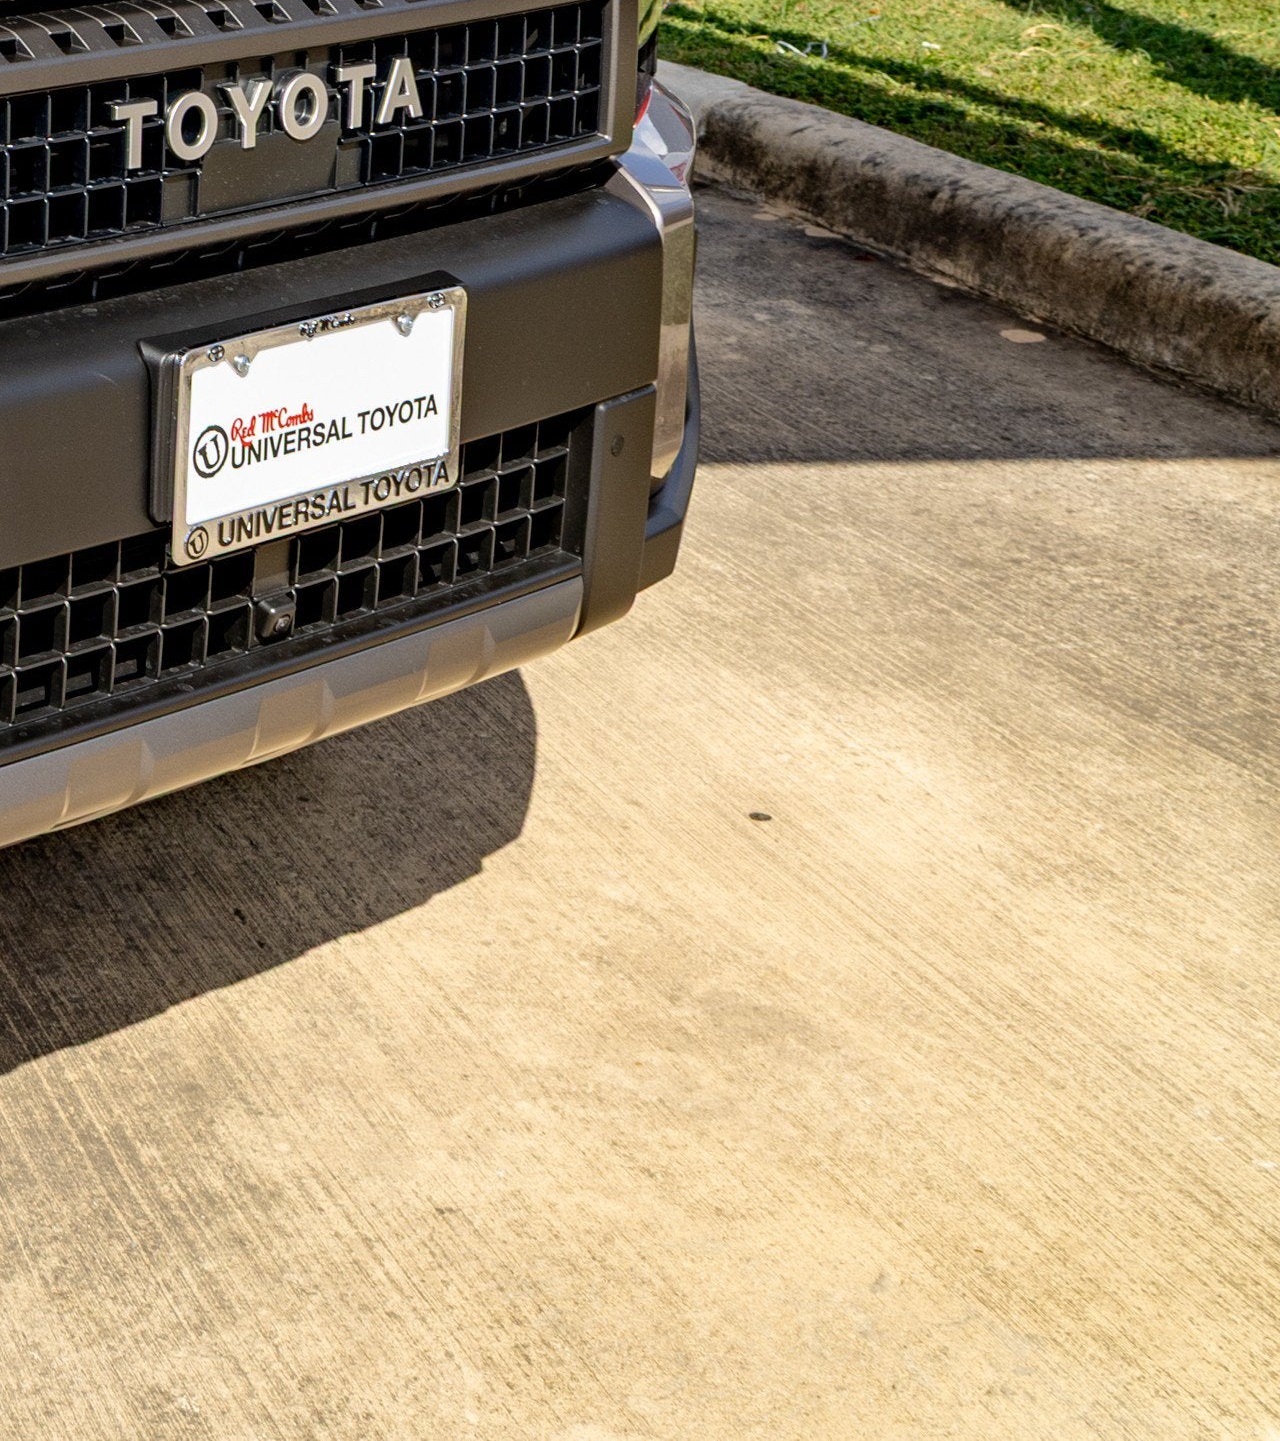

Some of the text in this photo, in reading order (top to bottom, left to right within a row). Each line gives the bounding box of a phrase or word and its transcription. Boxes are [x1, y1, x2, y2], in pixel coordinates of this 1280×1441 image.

[110, 57, 424, 170] TOYOTA
[231, 415, 257, 447] Red
[231, 394, 438, 469] UNIVERSAL TOYOTA
[217, 486, 356, 546] UNIVERSAL
[360, 459, 450, 505] TOYOTA
